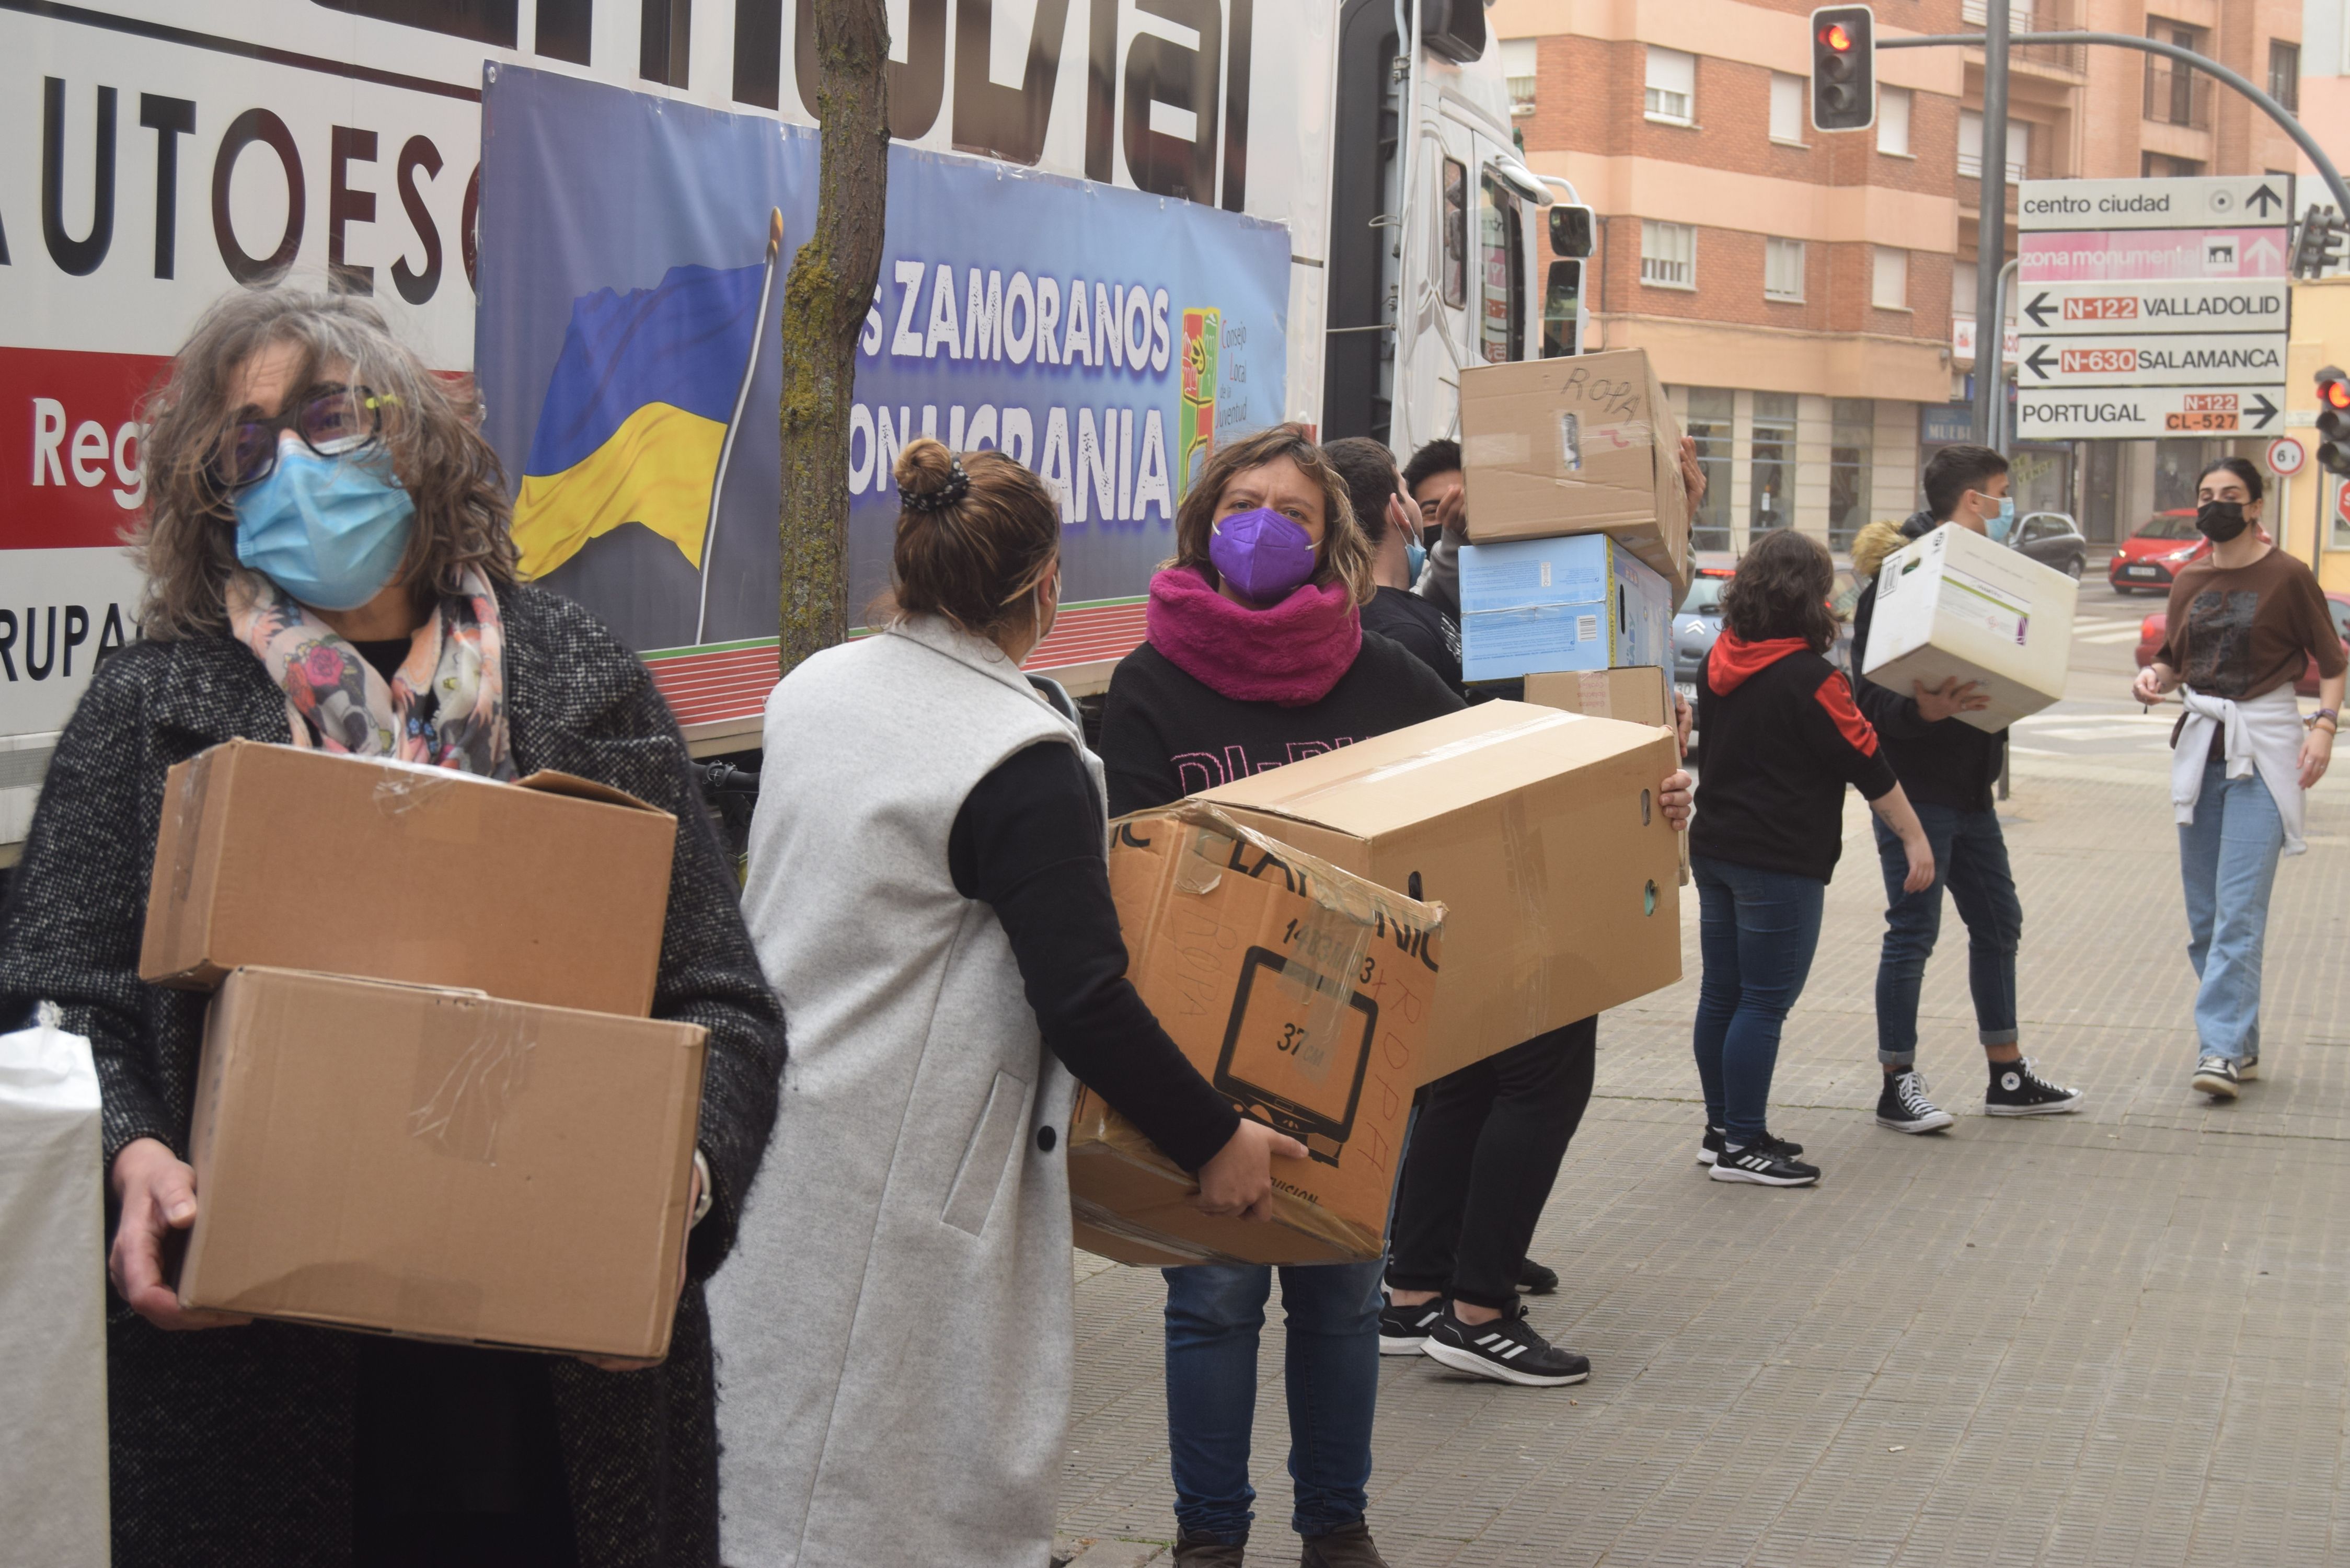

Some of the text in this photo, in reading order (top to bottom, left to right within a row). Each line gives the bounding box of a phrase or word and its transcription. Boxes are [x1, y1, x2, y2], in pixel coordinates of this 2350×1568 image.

[0, 76, 482, 305] UTOES
[2024, 194, 2170, 214] centro ciudad
[2021, 251, 2069, 267] zona
[857, 260, 1171, 372] S ZAMORANOS
[2067, 296, 2280, 319] N-122 VALLADOLID
[1221, 319, 1247, 351] Consejo
[1229, 352, 1247, 384] Local
[2064, 349, 2279, 371] N-630 SALAMANCA
[1561, 367, 1642, 425] ROPA
[2022, 395, 2237, 423] PORTUGAL N-122
[1215, 396, 1248, 429] Juventud
[2167, 414, 2238, 430] CL-527
[32, 398, 148, 510] Reg
[2277, 451, 2286, 463] 6
[1277, 1023, 1309, 1056] 37
